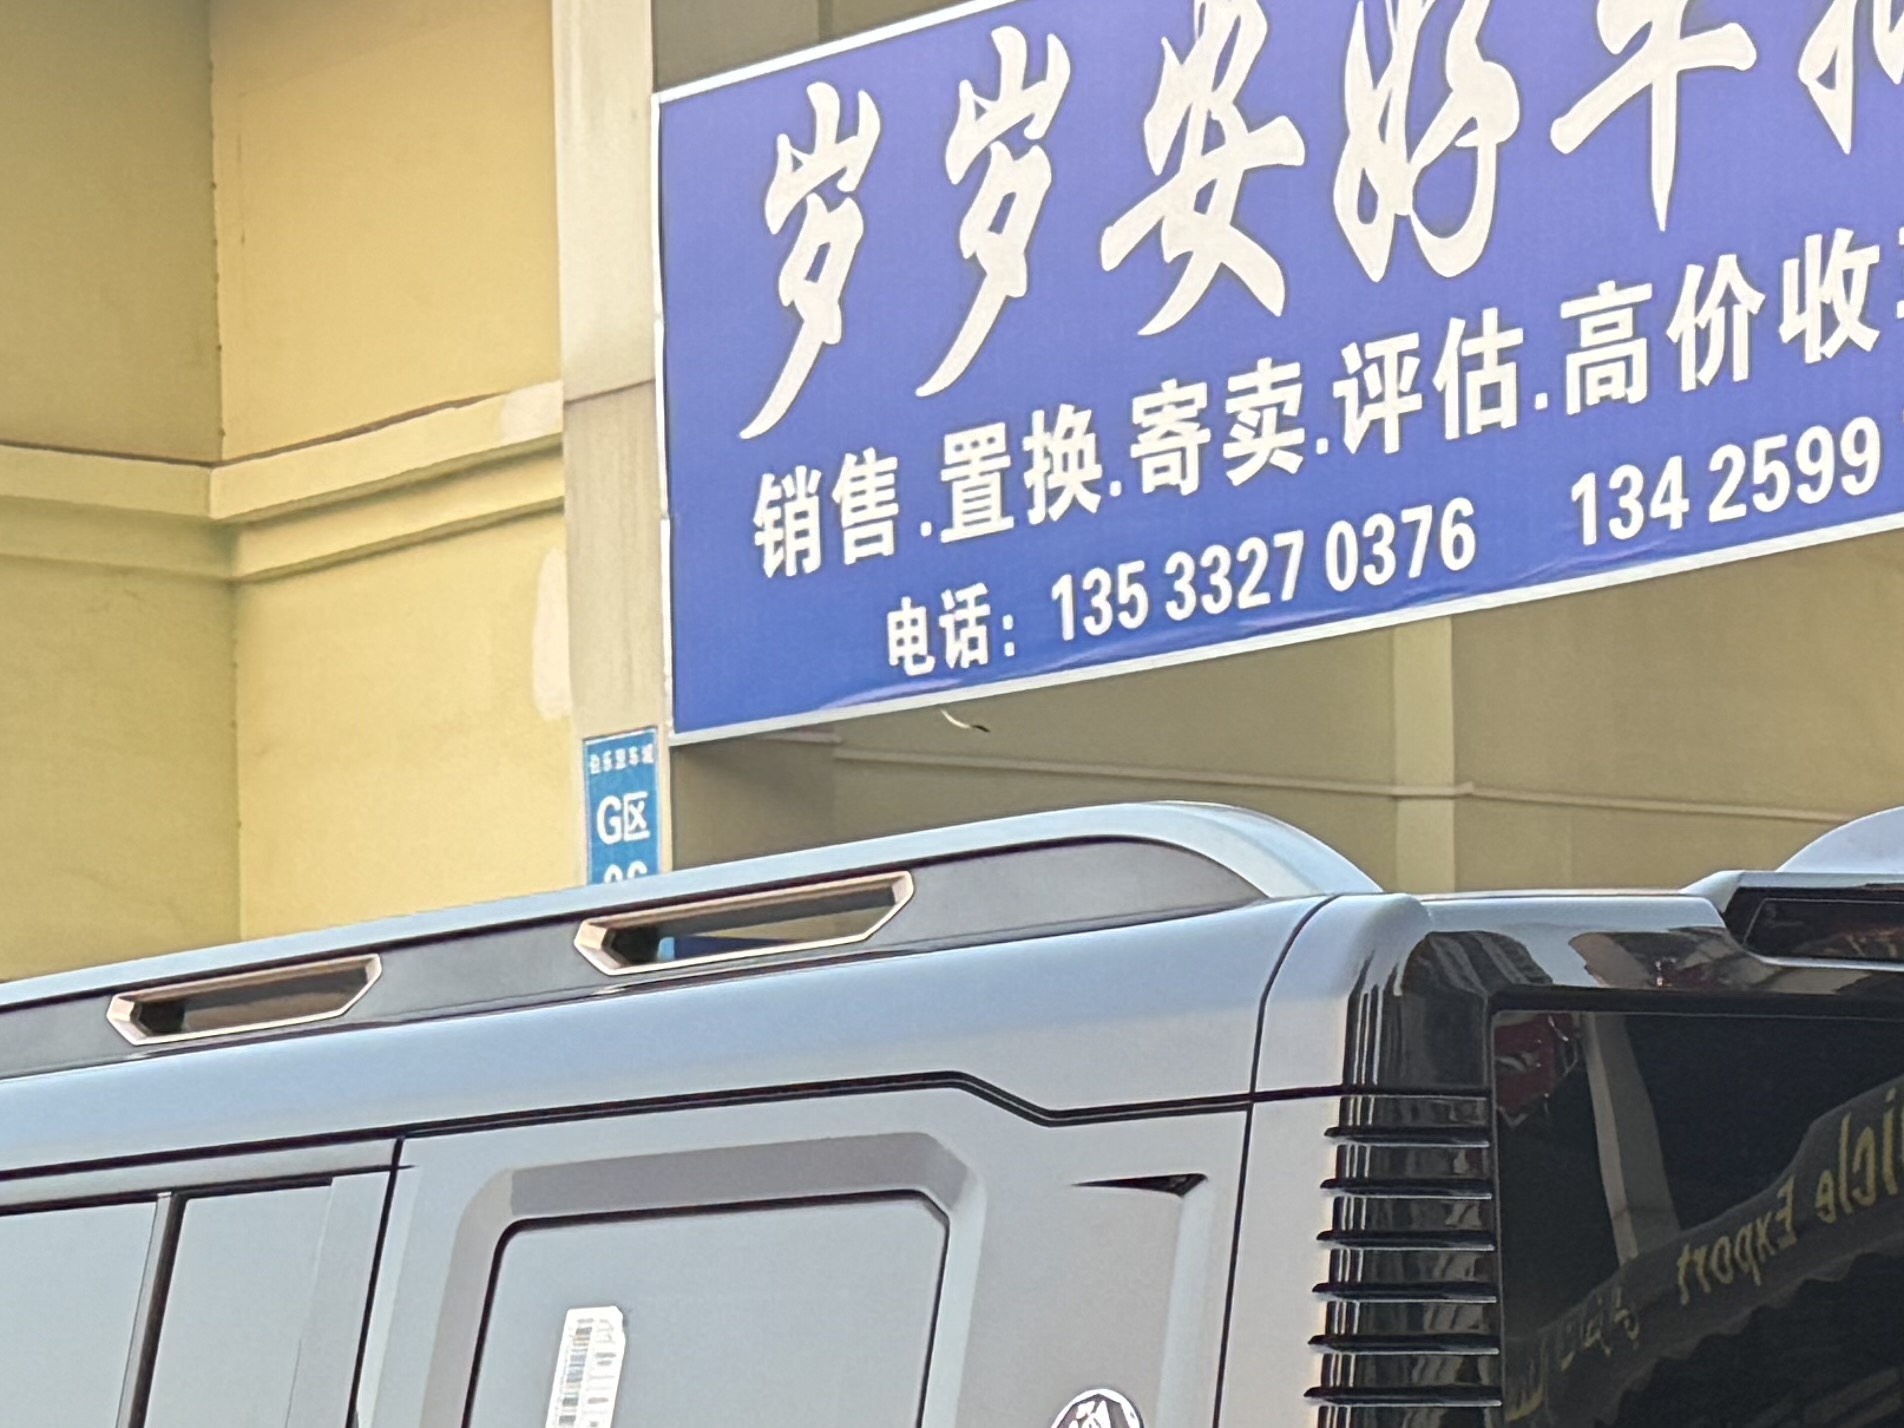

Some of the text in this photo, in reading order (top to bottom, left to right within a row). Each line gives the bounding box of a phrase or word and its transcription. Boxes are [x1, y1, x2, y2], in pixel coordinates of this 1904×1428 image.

[1051, 560, 1149, 640] 135
[1164, 530, 1304, 622] 3327
[1325, 495, 1477, 592] 0376
[1571, 455, 1689, 546] 134
[1707, 422, 1881, 525] 2599
[596, 791, 651, 845] G区
